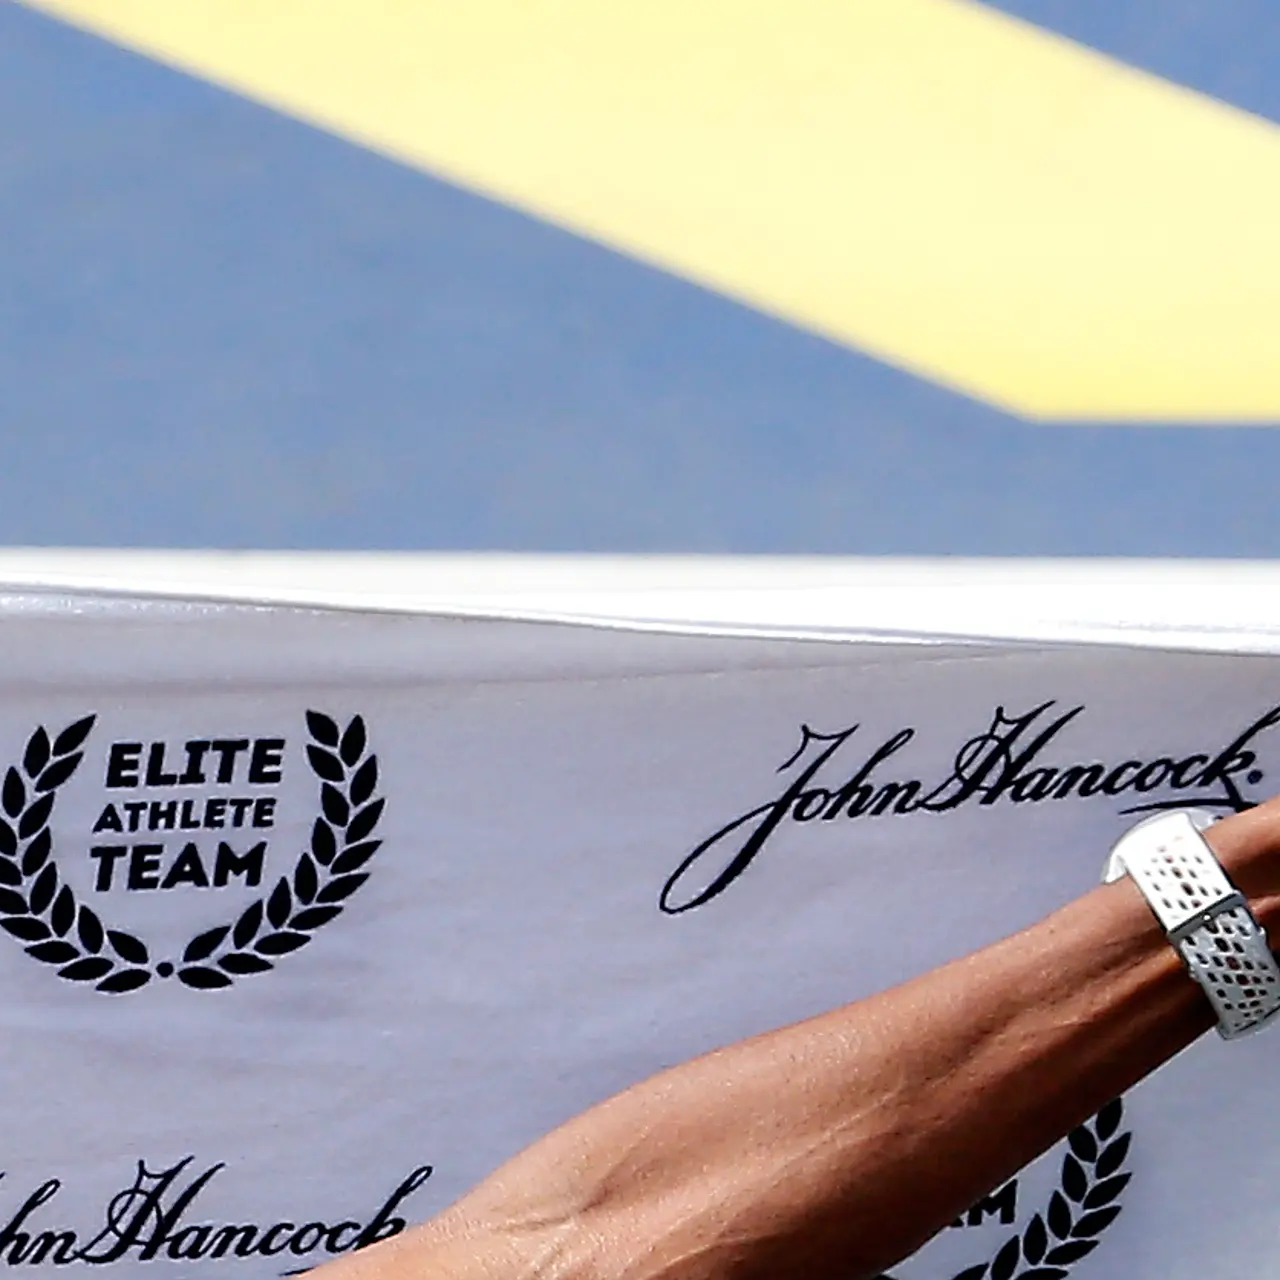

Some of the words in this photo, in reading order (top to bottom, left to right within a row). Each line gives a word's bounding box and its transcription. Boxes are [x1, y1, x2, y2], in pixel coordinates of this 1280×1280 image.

[105, 738, 286, 789] ELITE
[92, 797, 277, 833] ATHLETE
[660, 724, 930, 914] John
[90, 842, 268, 893] TEAM
